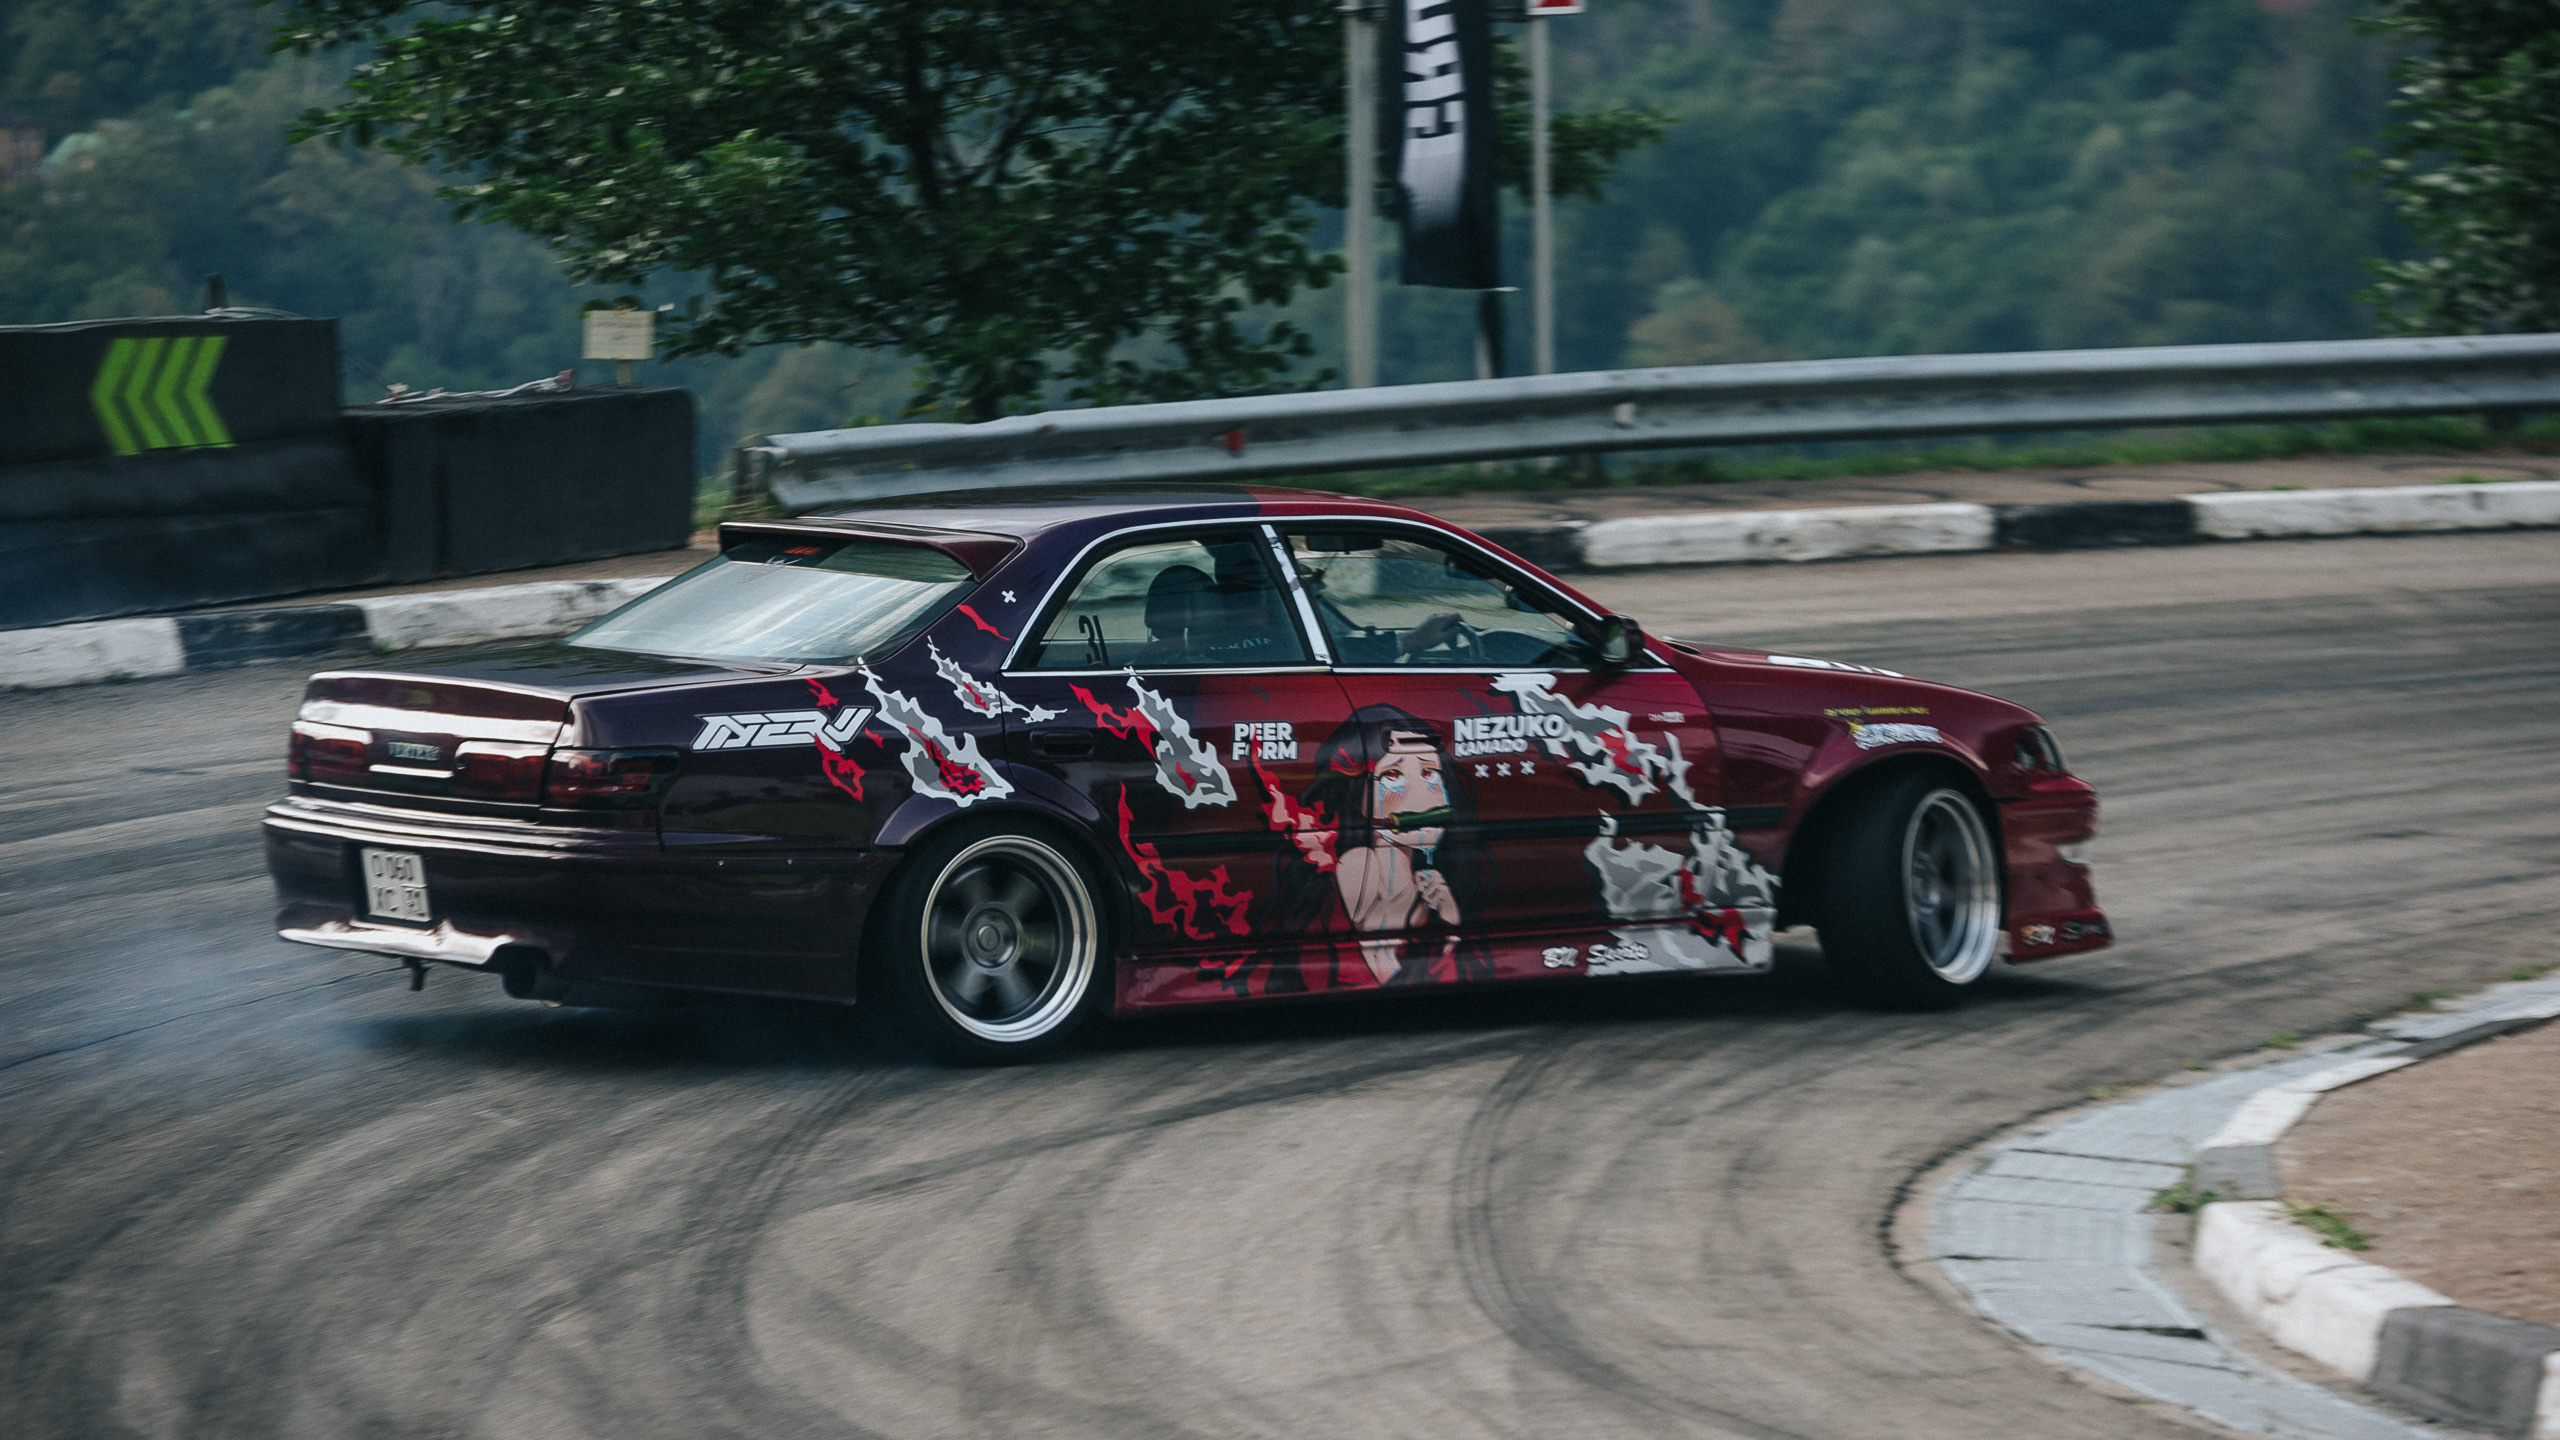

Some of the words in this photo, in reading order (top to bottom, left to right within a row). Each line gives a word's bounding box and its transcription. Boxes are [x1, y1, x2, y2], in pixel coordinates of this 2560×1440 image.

[1234, 722, 1294, 741] PEER
[1453, 714, 1567, 742] NEZUKO
[1454, 738, 1528, 757] KAMADO
